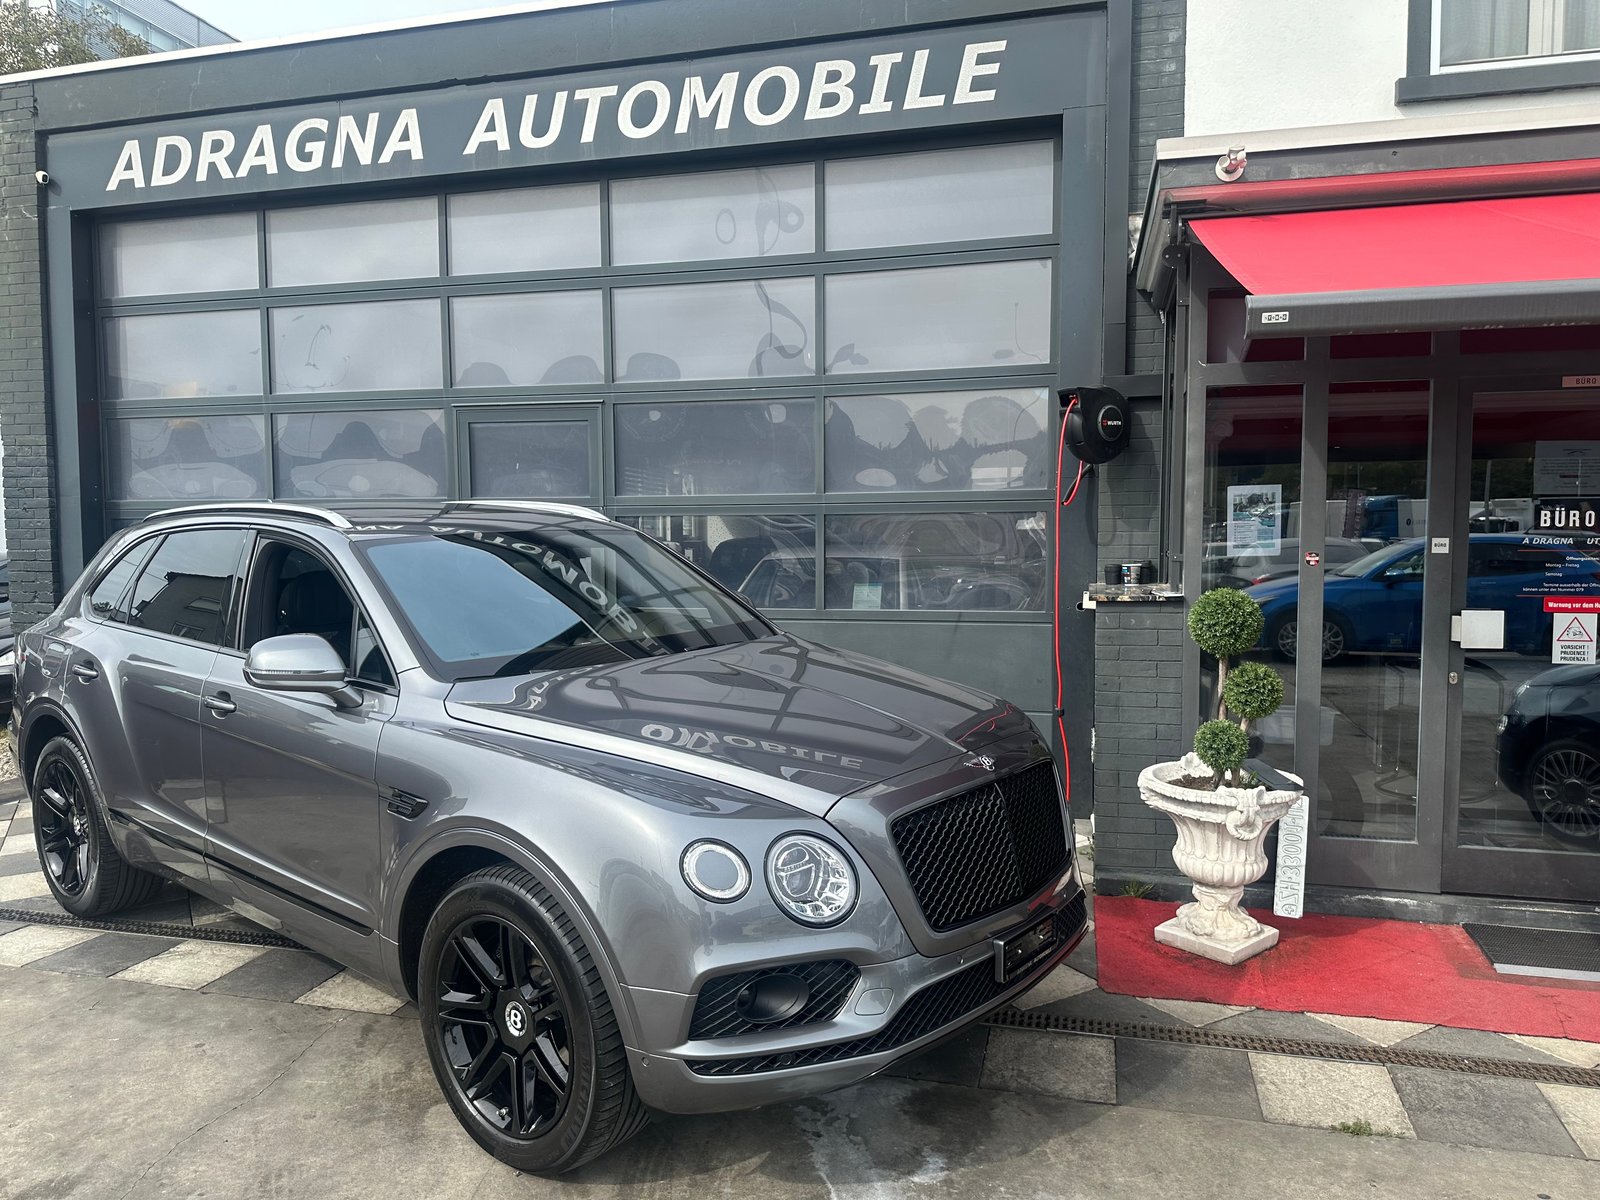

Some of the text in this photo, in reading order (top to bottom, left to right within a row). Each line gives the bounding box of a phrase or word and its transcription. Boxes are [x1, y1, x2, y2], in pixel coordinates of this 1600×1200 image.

[105, 39, 1008, 192] ADRAGNA AUTOMOBILE
[1575, 376, 1597, 385] BÜRO
[1540, 507, 1596, 528] BÜRO
[1586, 537, 1600, 546] UT
